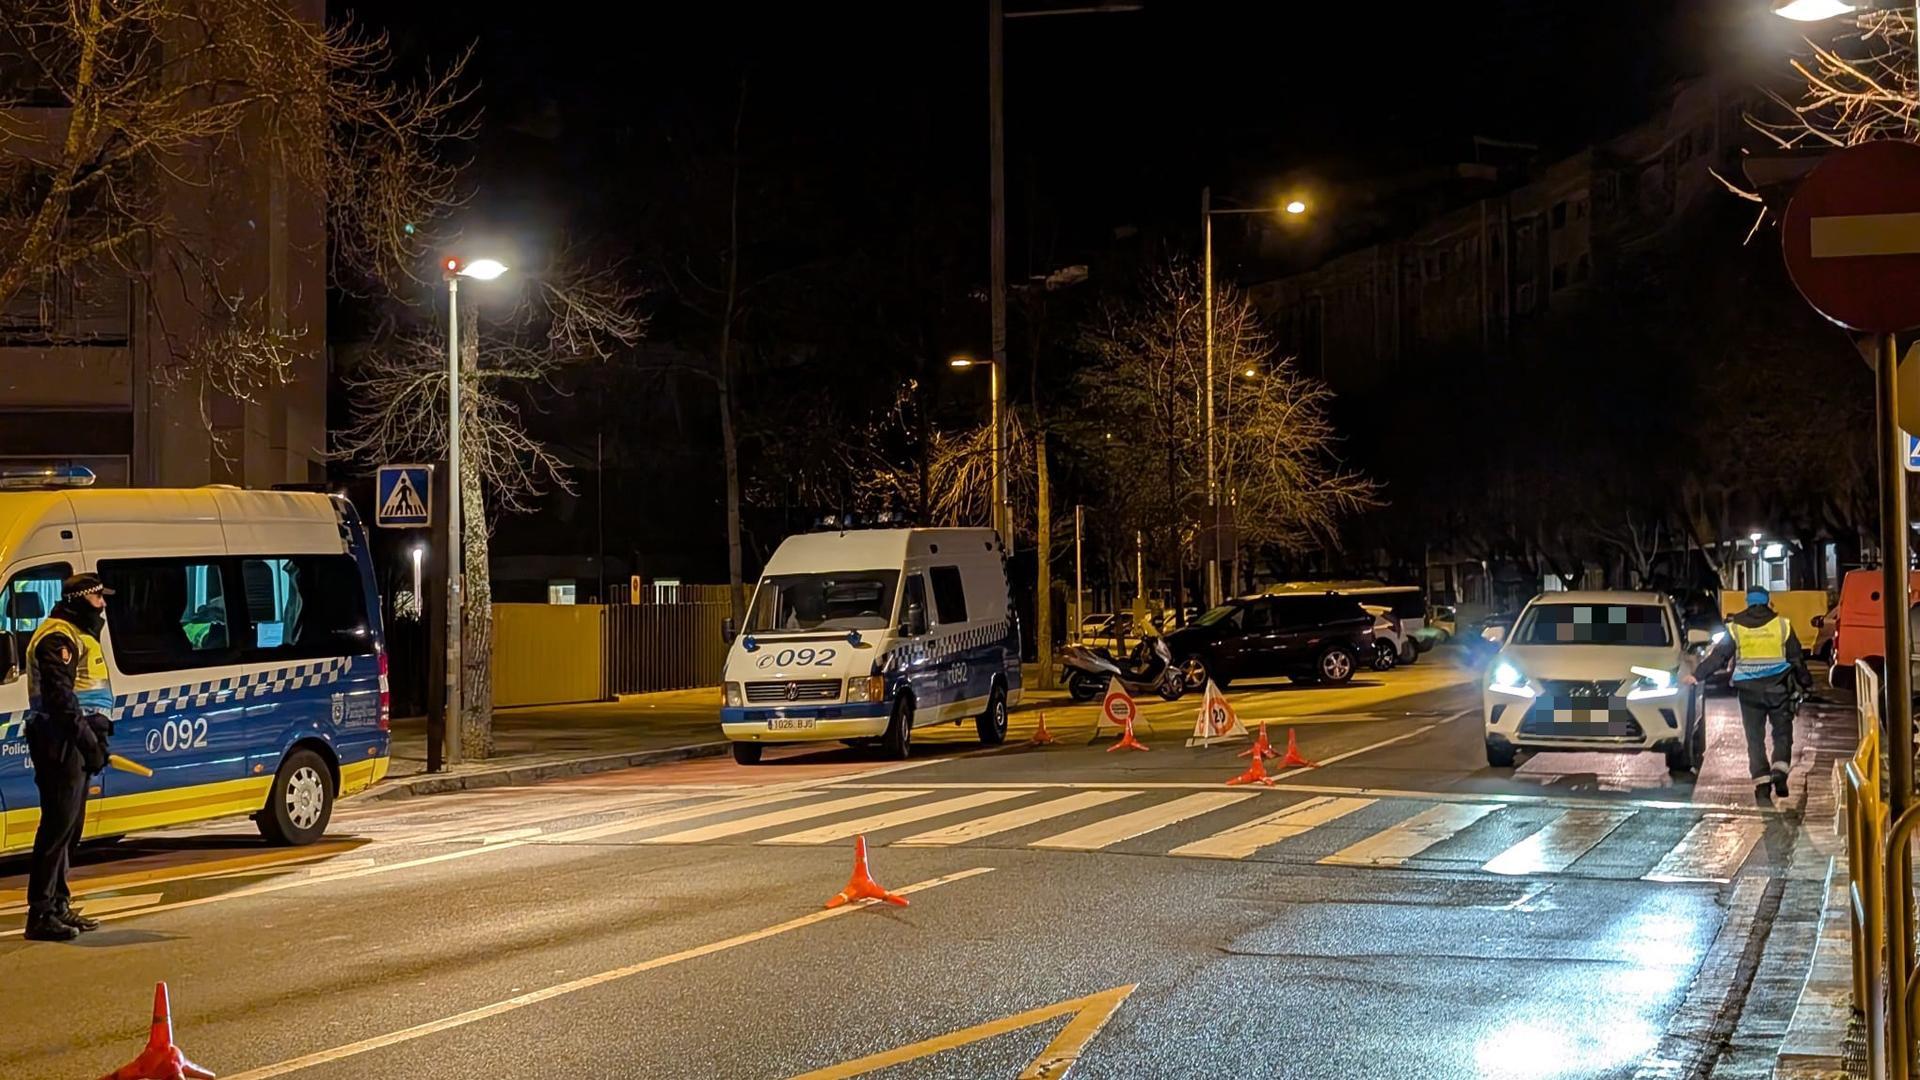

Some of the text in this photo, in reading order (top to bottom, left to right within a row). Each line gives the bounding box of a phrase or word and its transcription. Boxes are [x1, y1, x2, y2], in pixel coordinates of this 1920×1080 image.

[776, 648, 836, 667] 092
[951, 662, 968, 684] 092
[1212, 708, 1226, 723] 20
[163, 717, 208, 751] 092
